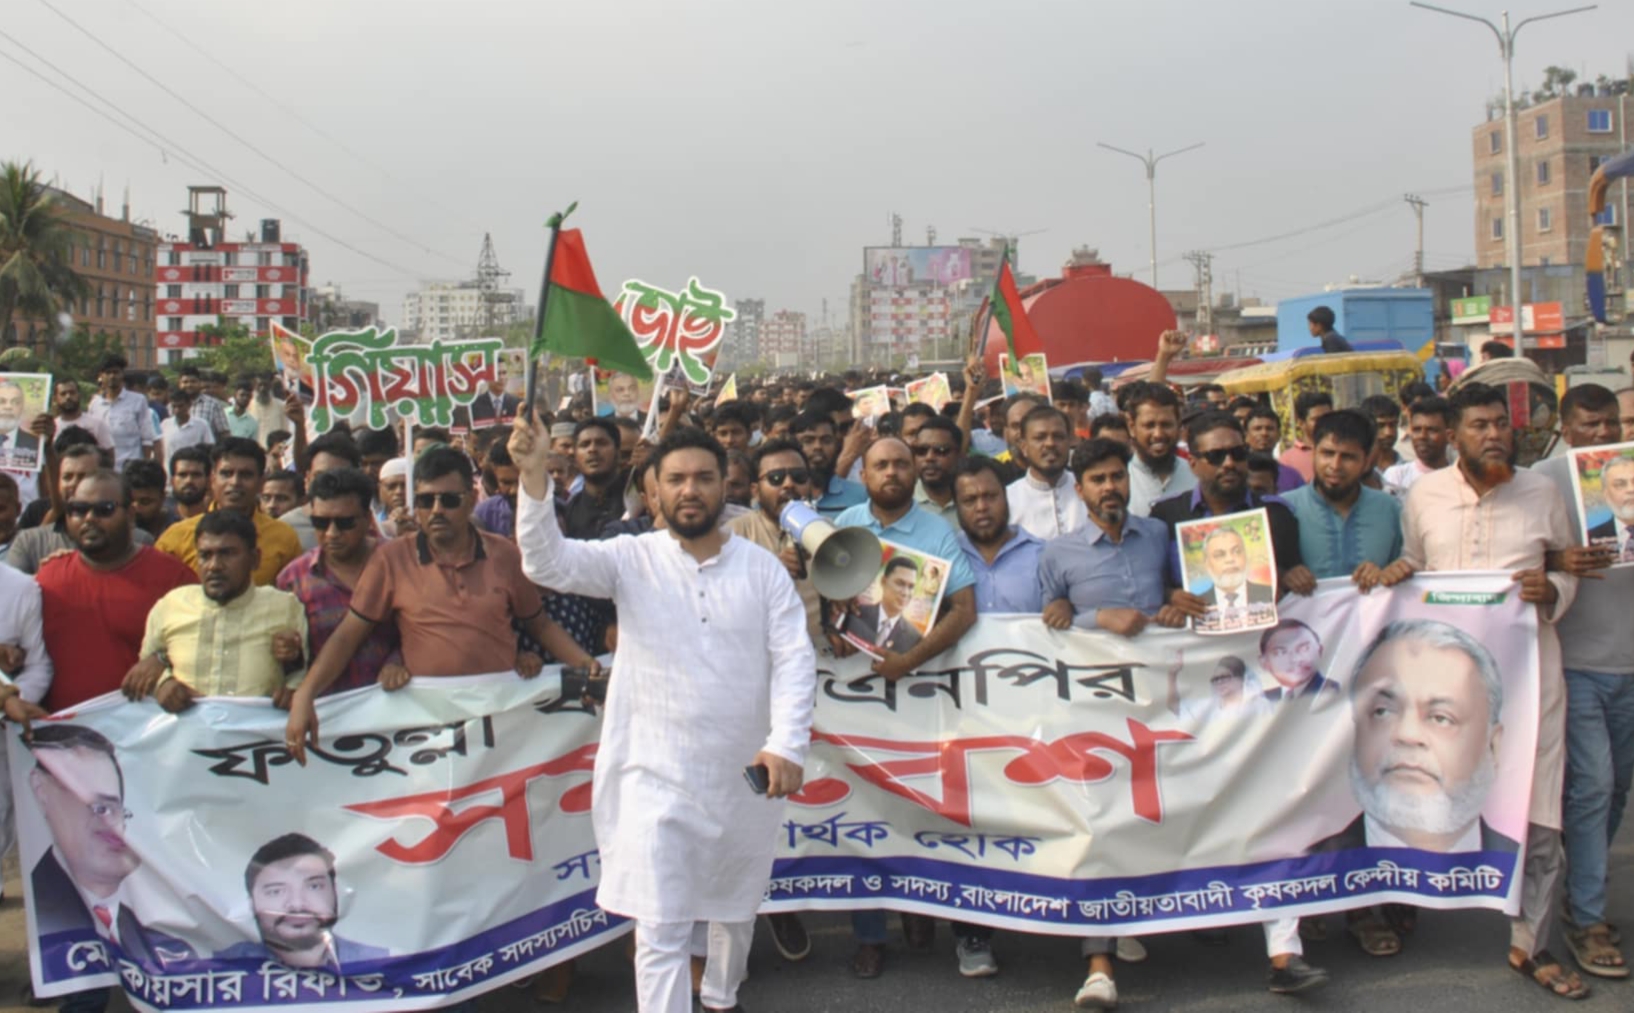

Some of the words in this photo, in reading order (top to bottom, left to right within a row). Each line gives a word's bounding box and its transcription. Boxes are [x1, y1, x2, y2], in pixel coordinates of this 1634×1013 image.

[306, 327, 503, 434] গিয়াস
[812, 648, 1147, 712] এনপির
[783, 811, 893, 849] ার্থক
[914, 831, 1043, 861] হোক
[118, 958, 248, 1004] কায়সার
[412, 952, 494, 993] সাবেক
[861, 875, 882, 892] ও
[1077, 880, 1233, 920] জাতীয়তাবাদী
[1240, 873, 1337, 909] কৃষকদল
[1426, 866, 1504, 891] কমিটি
